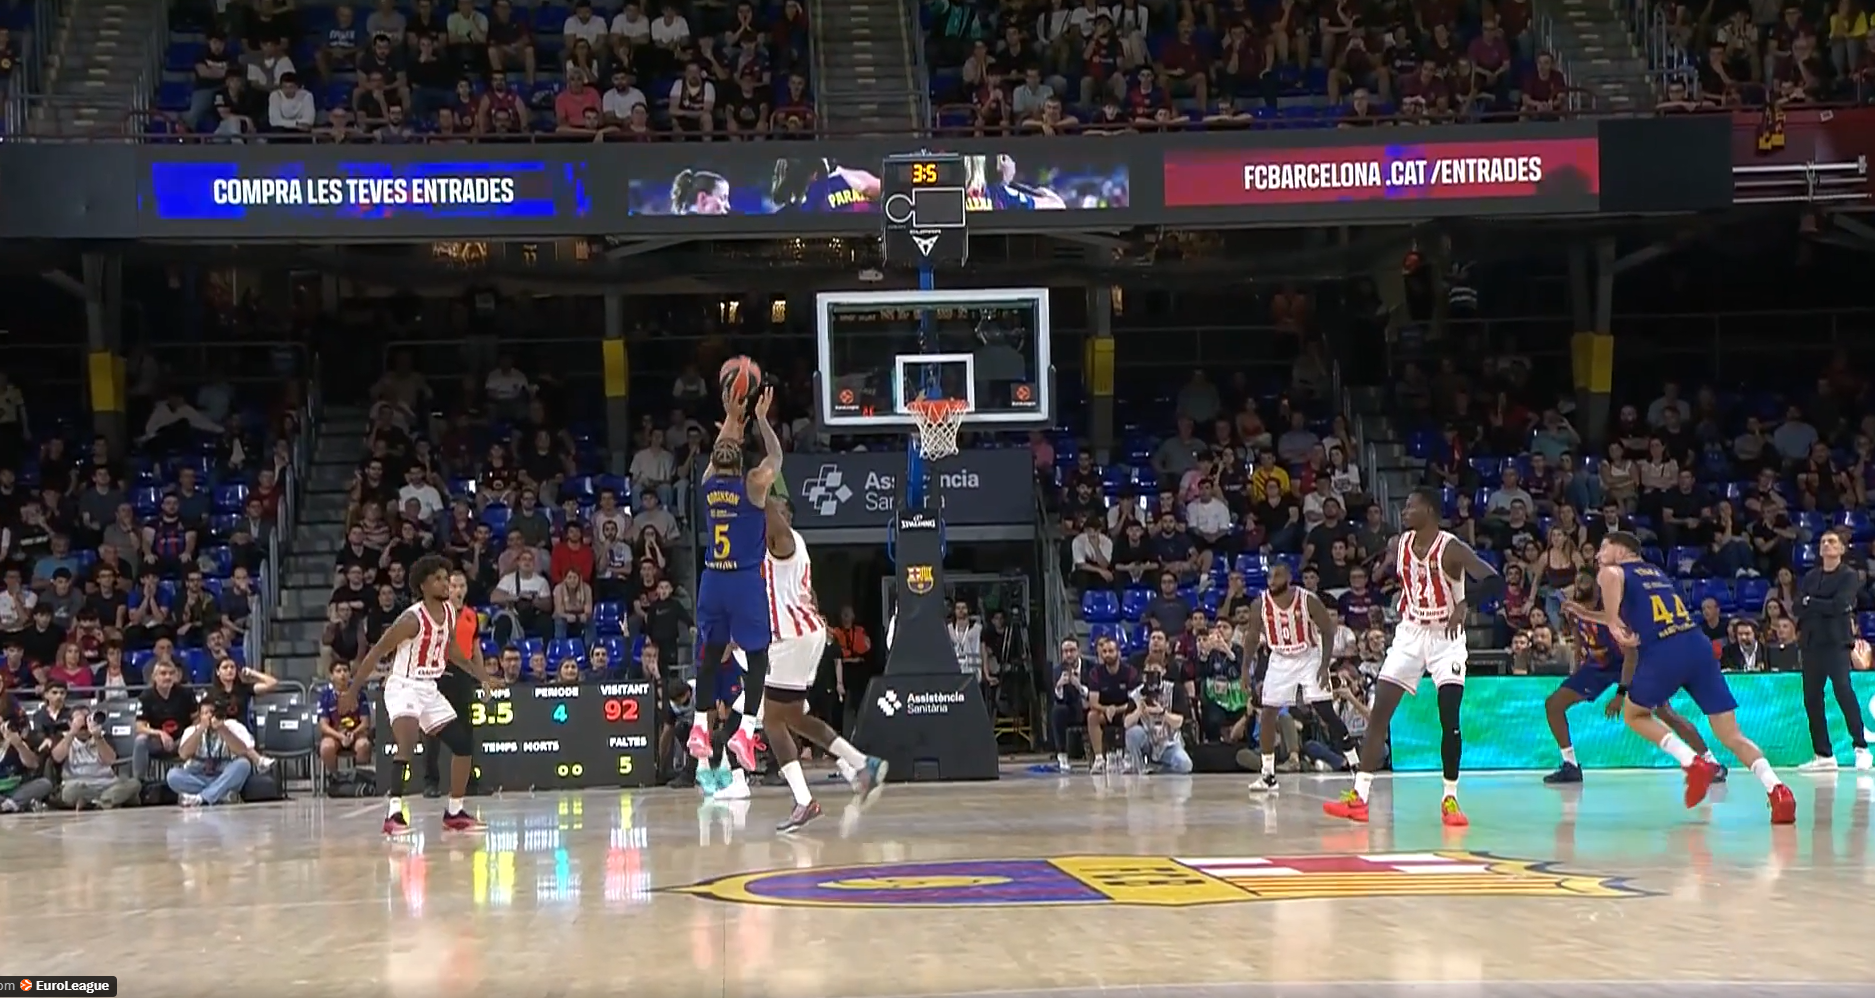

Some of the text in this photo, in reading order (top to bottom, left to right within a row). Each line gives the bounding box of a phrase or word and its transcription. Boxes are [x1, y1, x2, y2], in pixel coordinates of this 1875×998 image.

[1244, 161, 1381, 190] FCBARCELONA
[213, 177, 515, 205] COMPRA LES TEVES ENTRADES
[713, 523, 731, 559] 5
[1650, 594, 1692, 625] 44
[535, 686, 579, 698] PERIODE
[600, 684, 650, 696] VISITANT
[471, 702, 514, 725] 3.5
[553, 704, 568, 723] 4
[604, 699, 639, 721] 92
[482, 741, 518, 753] TEMPS
[618, 756, 633, 774] 5
